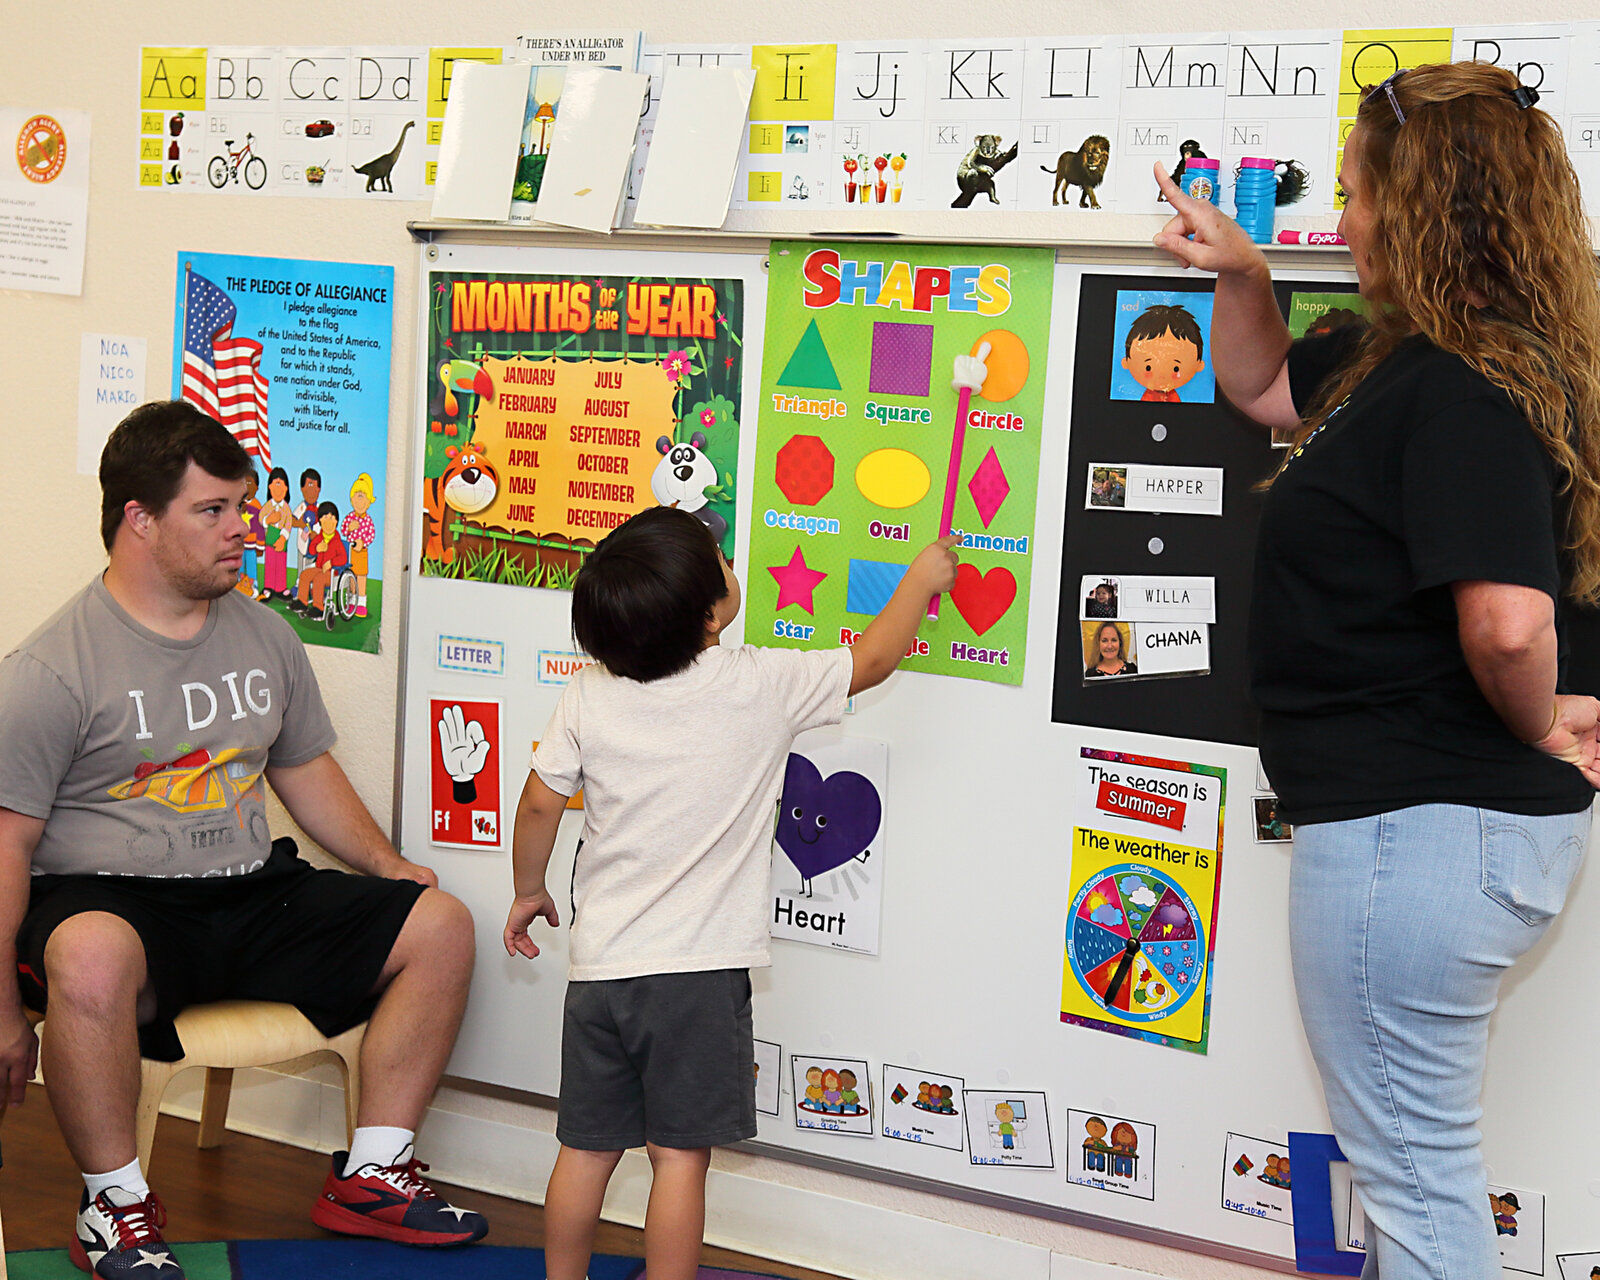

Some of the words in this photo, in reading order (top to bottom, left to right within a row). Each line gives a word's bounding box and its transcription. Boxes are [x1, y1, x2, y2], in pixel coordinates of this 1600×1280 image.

[526, 39, 561, 48] THERE'S
[563, 39, 576, 48] AN
[577, 38, 624, 49] ALLIGATOR
[542, 51, 570, 61] UNDER
[573, 51, 586, 61] MY
[588, 51, 606, 61] BED
[1310, 234, 1337, 245] EXPO
[226, 277, 246, 292] THE
[250, 279, 291, 296] PLEDGE
[295, 282, 311, 297] OF
[315, 284, 387, 303] ALLEGIANCE
[803, 249, 1012, 316] SHAPES
[284, 301, 286, 311] I
[288, 302, 315, 315] pledge
[317, 303, 357, 318] allegiance
[452, 280, 592, 334] MONTHS
[599, 288, 617, 308] OF
[626, 282, 717, 339] YEAR
[1121, 302, 1139, 312] sad
[1296, 299, 1330, 315] happy
[298, 318, 306, 327] to
[309, 318, 321, 328] the
[323, 319, 339, 332] flag
[258, 327, 267, 337] of
[268, 328, 279, 339] the
[282, 331, 307, 342] United
[309, 333, 332, 344] States
[335, 334, 344, 345] of
[346, 336, 381, 350] America,
[101, 339, 129, 358] NOA
[281, 347, 295, 355] and
[298, 347, 306, 356] to
[308, 347, 320, 357] the
[323, 349, 356, 362] Republic
[100, 364, 134, 379] NICO
[280, 358, 292, 369] for
[294, 360, 317, 372] which
[320, 362, 325, 373] it
[327, 364, 355, 376] stands,
[503, 366, 555, 386] JANUARY
[274, 375, 288, 384] one
[290, 375, 315, 386] nation
[317, 378, 340, 389] under
[342, 380, 362, 392] God,
[594, 371, 622, 389] JULY
[96, 387, 137, 405] MARIO
[295, 389, 337, 404] indivisible,
[499, 393, 557, 414] FEBRUARY
[294, 405, 310, 415] with
[313, 405, 339, 420] liberty
[584, 398, 630, 418] AUGUST
[772, 394, 847, 419] Triangle
[864, 402, 932, 425] Square
[280, 418, 294, 428] and
[296, 419, 322, 432] justice
[324, 420, 336, 432] for
[338, 422, 350, 434] all.
[968, 411, 1025, 431] Circle
[505, 421, 547, 441] MARCH
[570, 425, 641, 448] SEPTEMBER
[508, 449, 540, 468] APRIL
[577, 453, 629, 475] OCTOBER
[509, 476, 536, 495] MAY
[568, 481, 635, 503] NOVEMBER
[1146, 479, 1203, 494] HARPER
[507, 504, 535, 523] JUNE
[764, 509, 840, 535] Octagon
[868, 520, 911, 541] Oval
[951, 528, 1029, 554] iamond
[1145, 589, 1190, 603] WILLA
[773, 619, 815, 640] Star
[1146, 630, 1202, 648] CHANA
[447, 645, 492, 664] LETTER
[951, 642, 1010, 666] Heart
[547, 660, 592, 676] NUM
[128, 690, 153, 739] I
[181, 669, 271, 731] DIG
[1088, 766, 1120, 784] The
[1126, 775, 1188, 799] season
[1193, 783, 1207, 801] is
[1107, 790, 1176, 820] summer
[434, 810, 450, 831] Ff
[1078, 828, 1110, 850] The
[1114, 839, 1190, 865] weather
[1195, 851, 1209, 869] is
[1130, 864, 1152, 875] Cloudy
[1073, 888, 1087, 908] Partly
[1085, 872, 1105, 890] Cloudy
[775, 897, 846, 935] Heart
[1184, 897, 1199, 921] Stormy
[1192, 961, 1204, 985] Snowy
[1148, 1011, 1167, 1021] Windy
[1256, 1201, 1270, 1209] Music
